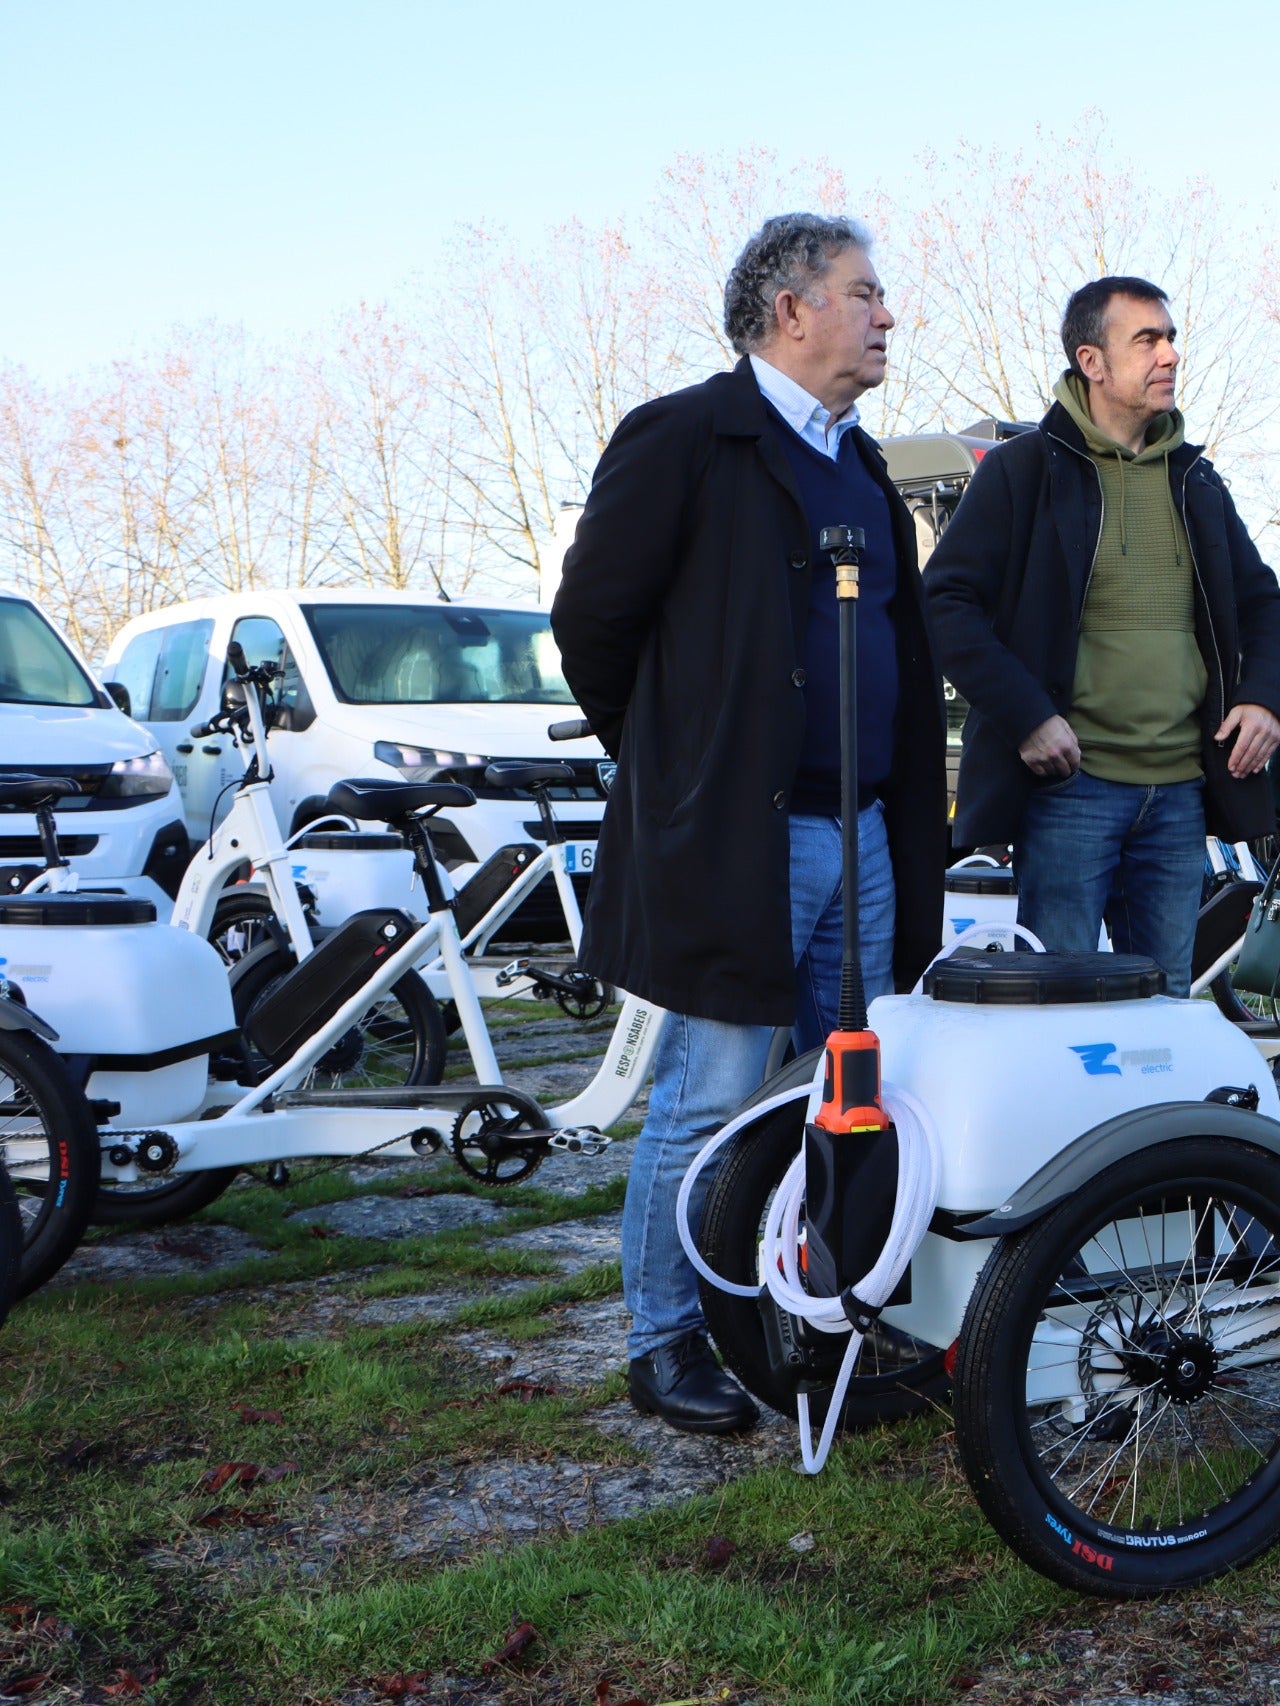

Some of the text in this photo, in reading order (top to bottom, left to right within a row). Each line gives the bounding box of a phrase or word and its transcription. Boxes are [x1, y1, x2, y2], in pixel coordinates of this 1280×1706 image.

[1141, 1063, 1174, 1074] electric
[1044, 1512, 1073, 1545] Tyres
[1126, 1535, 1177, 1547] BRUTUS
[1071, 1539, 1114, 1571] DSI
